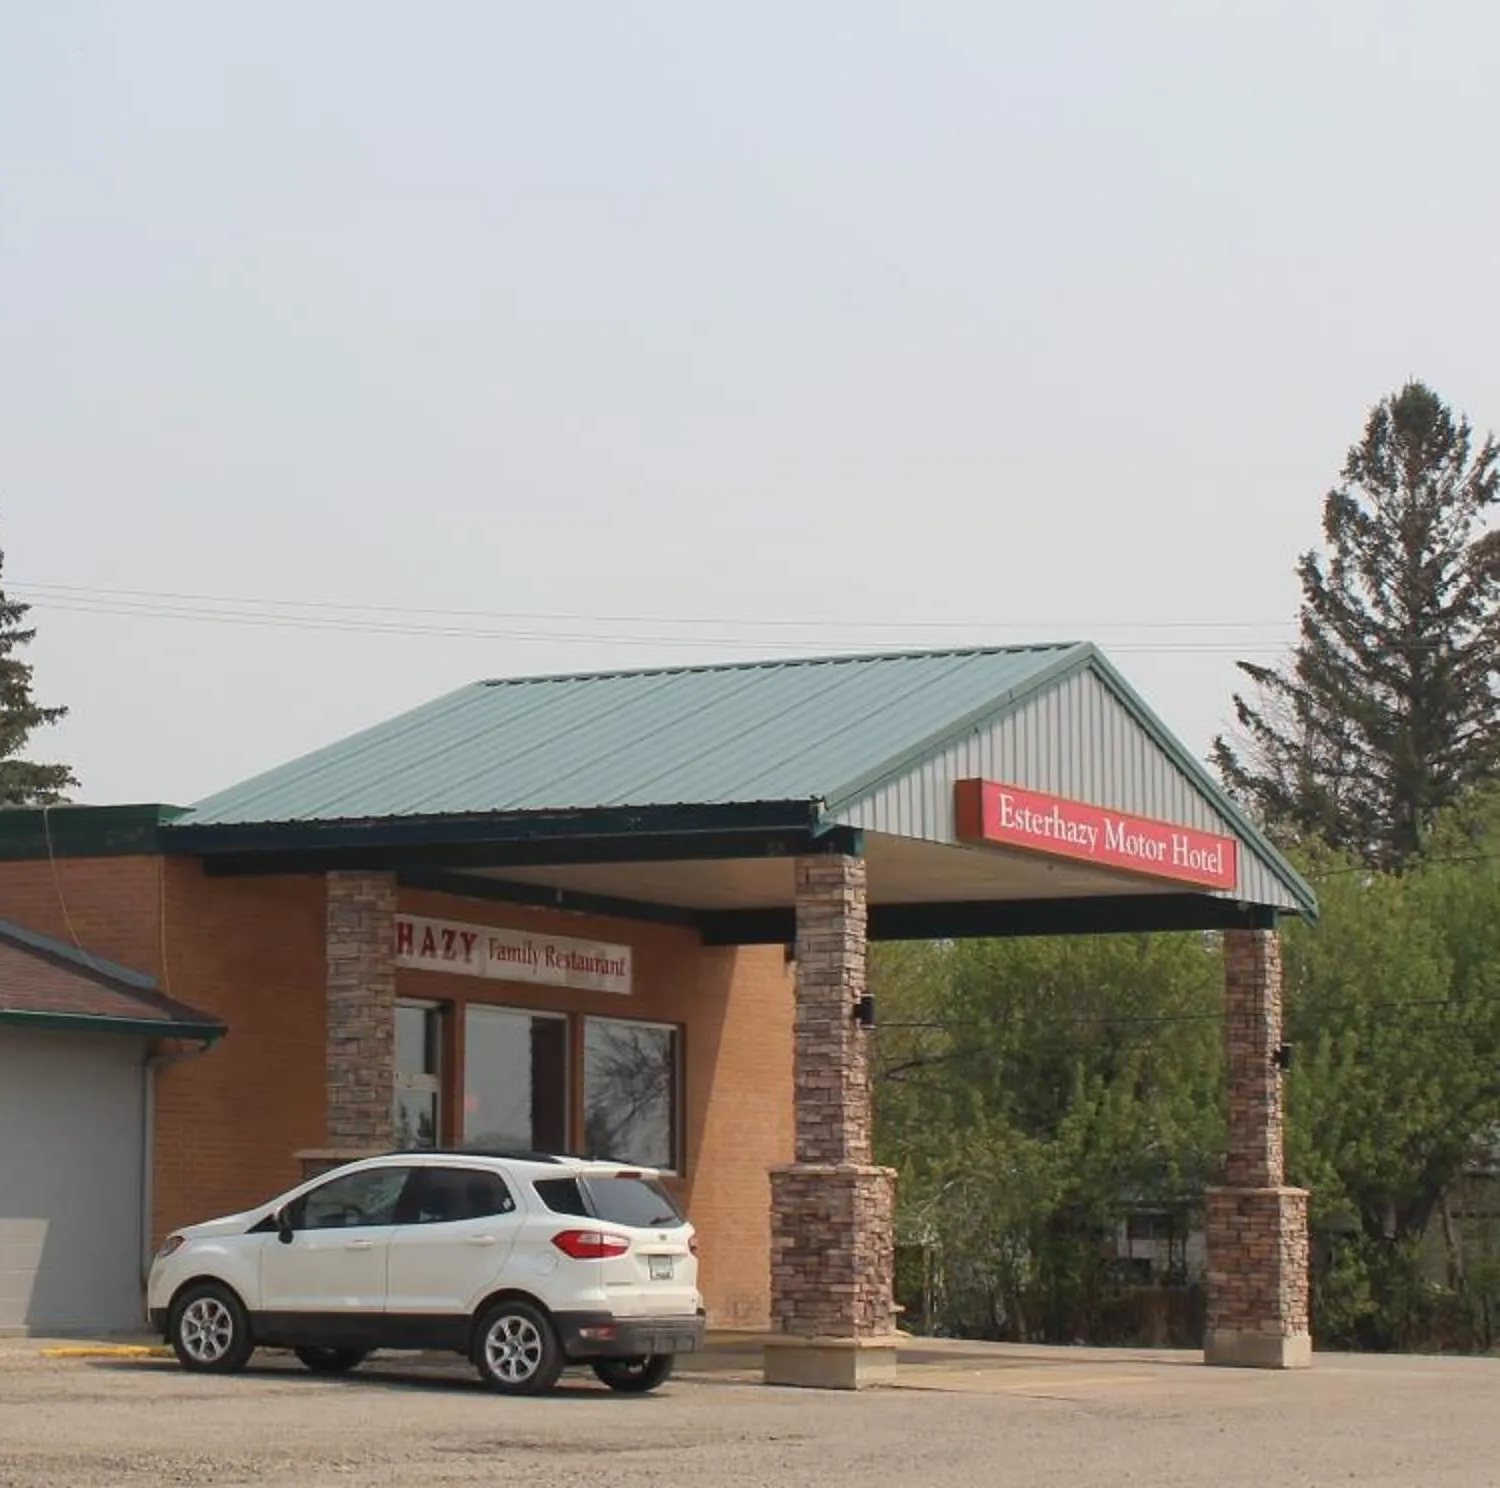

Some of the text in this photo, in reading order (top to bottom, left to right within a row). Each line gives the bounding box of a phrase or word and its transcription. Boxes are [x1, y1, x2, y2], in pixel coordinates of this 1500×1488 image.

[998, 793, 1223, 874] Esterhazy Motor Hotel
[488, 937, 540, 975] Family
[544, 944, 625, 977] Restaurant
